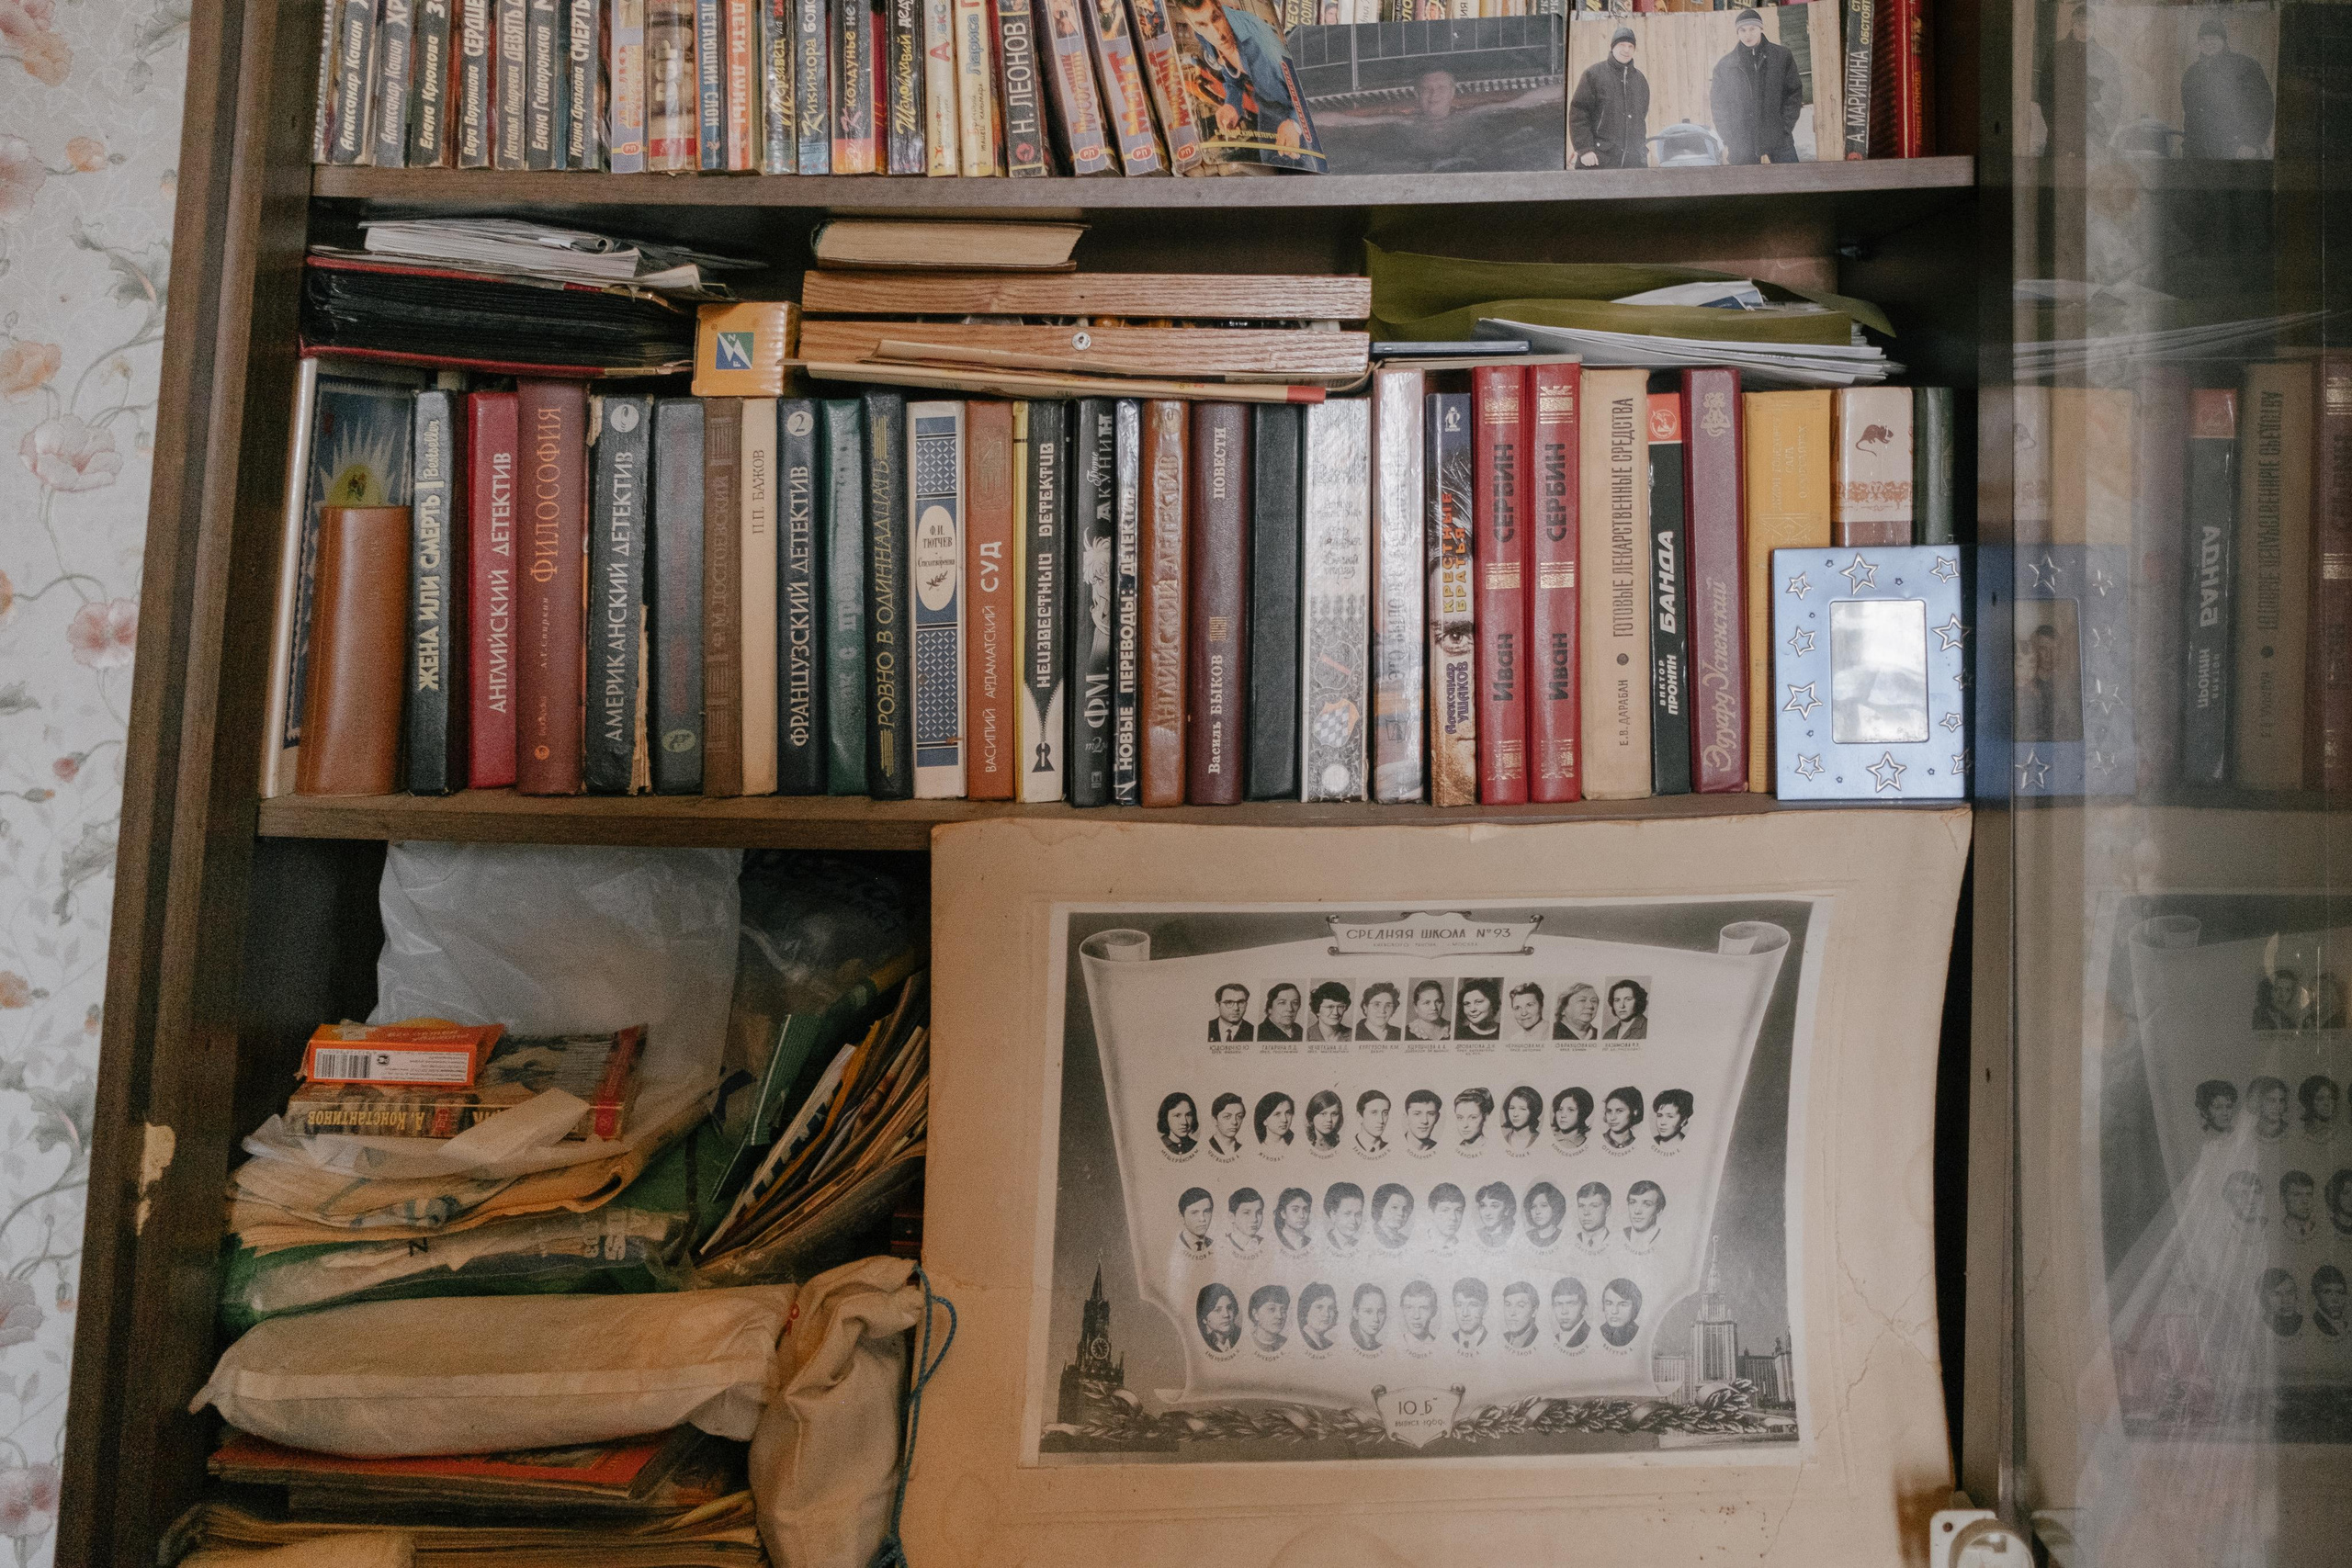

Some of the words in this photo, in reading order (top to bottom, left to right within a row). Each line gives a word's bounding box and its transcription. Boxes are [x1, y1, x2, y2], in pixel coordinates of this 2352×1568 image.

[346, 19, 363, 69] Кашин
[503, 9, 525, 62] ДЕВЯТЬ
[731, 1, 746, 53] ДЕТИ
[846, 6, 856, 26] не
[966, 14, 983, 76] Лариса
[385, 39, 404, 79] Кашин
[422, 34, 439, 102] Крюкова
[504, 64, 522, 115] Андреева
[533, 26, 552, 111] Гайворонская
[571, 66, 586, 120] Дроздова
[769, 38, 792, 127] Мерзавец
[801, 37, 825, 136] Кикимора
[843, 30, 858, 107] колдунье
[895, 34, 917, 134] Шаловливый
[1003, 22, 1034, 107] ЛЕОНОВ
[1847, 51, 1868, 127] МАРИНИНА
[340, 73, 361, 151] Александр
[380, 81, 403, 145] Александр
[420, 106, 435, 150] Елена
[464, 64, 481, 126] Воронцова
[704, 92, 719, 127] СЛОН
[732, 64, 746, 124] ЛУНЫ
[464, 129, 480, 156] Вера
[504, 117, 520, 160] Наталья
[532, 114, 548, 151] Елена
[571, 122, 585, 157] Ирина
[424, 419, 440, 479] Bestseller
[792, 413, 807, 434] 2
[1611, 397, 1635, 462] СРЕДСТВА
[530, 407, 561, 582] ФИЛОСОФИЯ
[752, 449, 765, 501] БАЖОВ
[1038, 442, 1054, 536] ДЕТЕКТИВ
[1096, 413, 1113, 522] АКУНИН
[1213, 426, 1227, 498] ПОВЕСТИ
[1493, 443, 1515, 543] СЕРБИН
[1545, 443, 1567, 543] СЕРБИН
[419, 494, 441, 569] СМЕРТЬ
[492, 451, 513, 557] ДЕТЕКТИВ
[612, 451, 634, 557] ДЕТЕКТИВ
[790, 465, 809, 573] ДЕТЕКТИВ
[1119, 488, 1136, 576] ДЕТЕКТИВ
[1157, 454, 1179, 569] ДЕТЕКТИВ
[1612, 465, 1634, 575] ЛЕКАРСТВЕННЫЕ
[873, 458, 894, 624] ОДИННАДЦАТЬ
[922, 537, 953, 548] ТЮТЧЕВ
[978, 541, 1002, 592] СУД
[1441, 492, 1453, 614] КРЕСТНЫЕ
[1454, 526, 1467, 613] БРАТЬЯ
[419, 577, 441, 621] ИЛИ
[1614, 580, 1634, 637] ГОТОВЫЕ
[1657, 531, 1676, 635] БАНДА
[486, 569, 511, 714] АНГЛИЙСКИЙ
[605, 563, 630, 741] АМЕРИКАНСКИЙ
[876, 629, 894, 645] В
[981, 604, 998, 698] АРДАМАТСКИЙ
[1036, 552, 1053, 689] НЕИЗВЕСТНЫЙ
[1119, 589, 1136, 693] ПЕРЕВОДЫ:
[1702, 578, 1730, 692] Успенский
[418, 625, 441, 691] ЖЕНА
[787, 581, 810, 747] ФРАНЦУЗСКИЙ
[876, 651, 897, 728] РОВНО
[1210, 654, 1223, 715] БЫКОВ
[1456, 660, 1469, 722] УШАКОВ
[1493, 633, 1514, 702] Иван
[1548, 632, 1568, 700] Иван
[1666, 655, 1679, 716] ПРОНИН
[983, 707, 997, 773] ВАСИЛИЙ
[1119, 706, 1134, 771] НОВЫЕ
[1207, 721, 1222, 774] Василь
[1702, 689, 1736, 773] Эдуард
[1346, 929, 1415, 939] СРЕДНЯЯ
[1420, 929, 1465, 939] ШКОЛА
